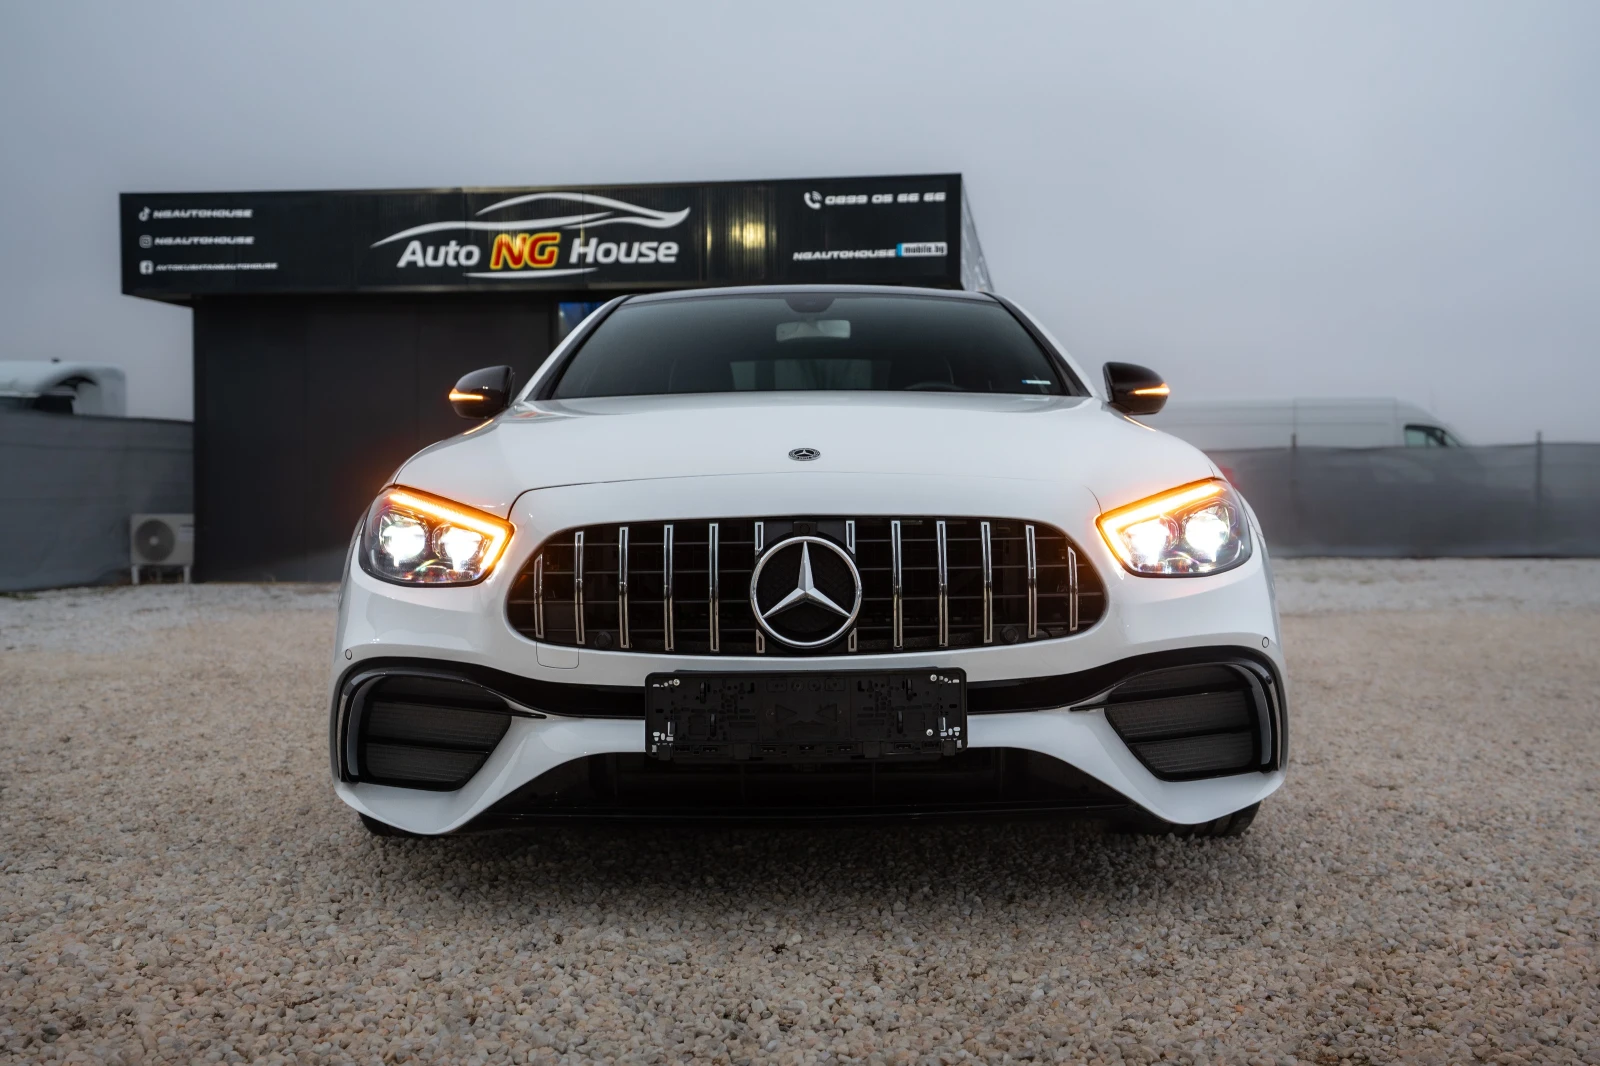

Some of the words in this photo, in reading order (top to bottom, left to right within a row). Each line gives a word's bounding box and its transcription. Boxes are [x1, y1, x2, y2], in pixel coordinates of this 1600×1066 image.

[153, 209, 253, 219] NGAUTOHOUSE
[154, 236, 255, 246] NGAUTOHOUSE
[397, 240, 480, 267] Auto
[490, 232, 561, 270] NG
[568, 237, 679, 263] House
[793, 249, 896, 260] NGAUTOHOUSE
